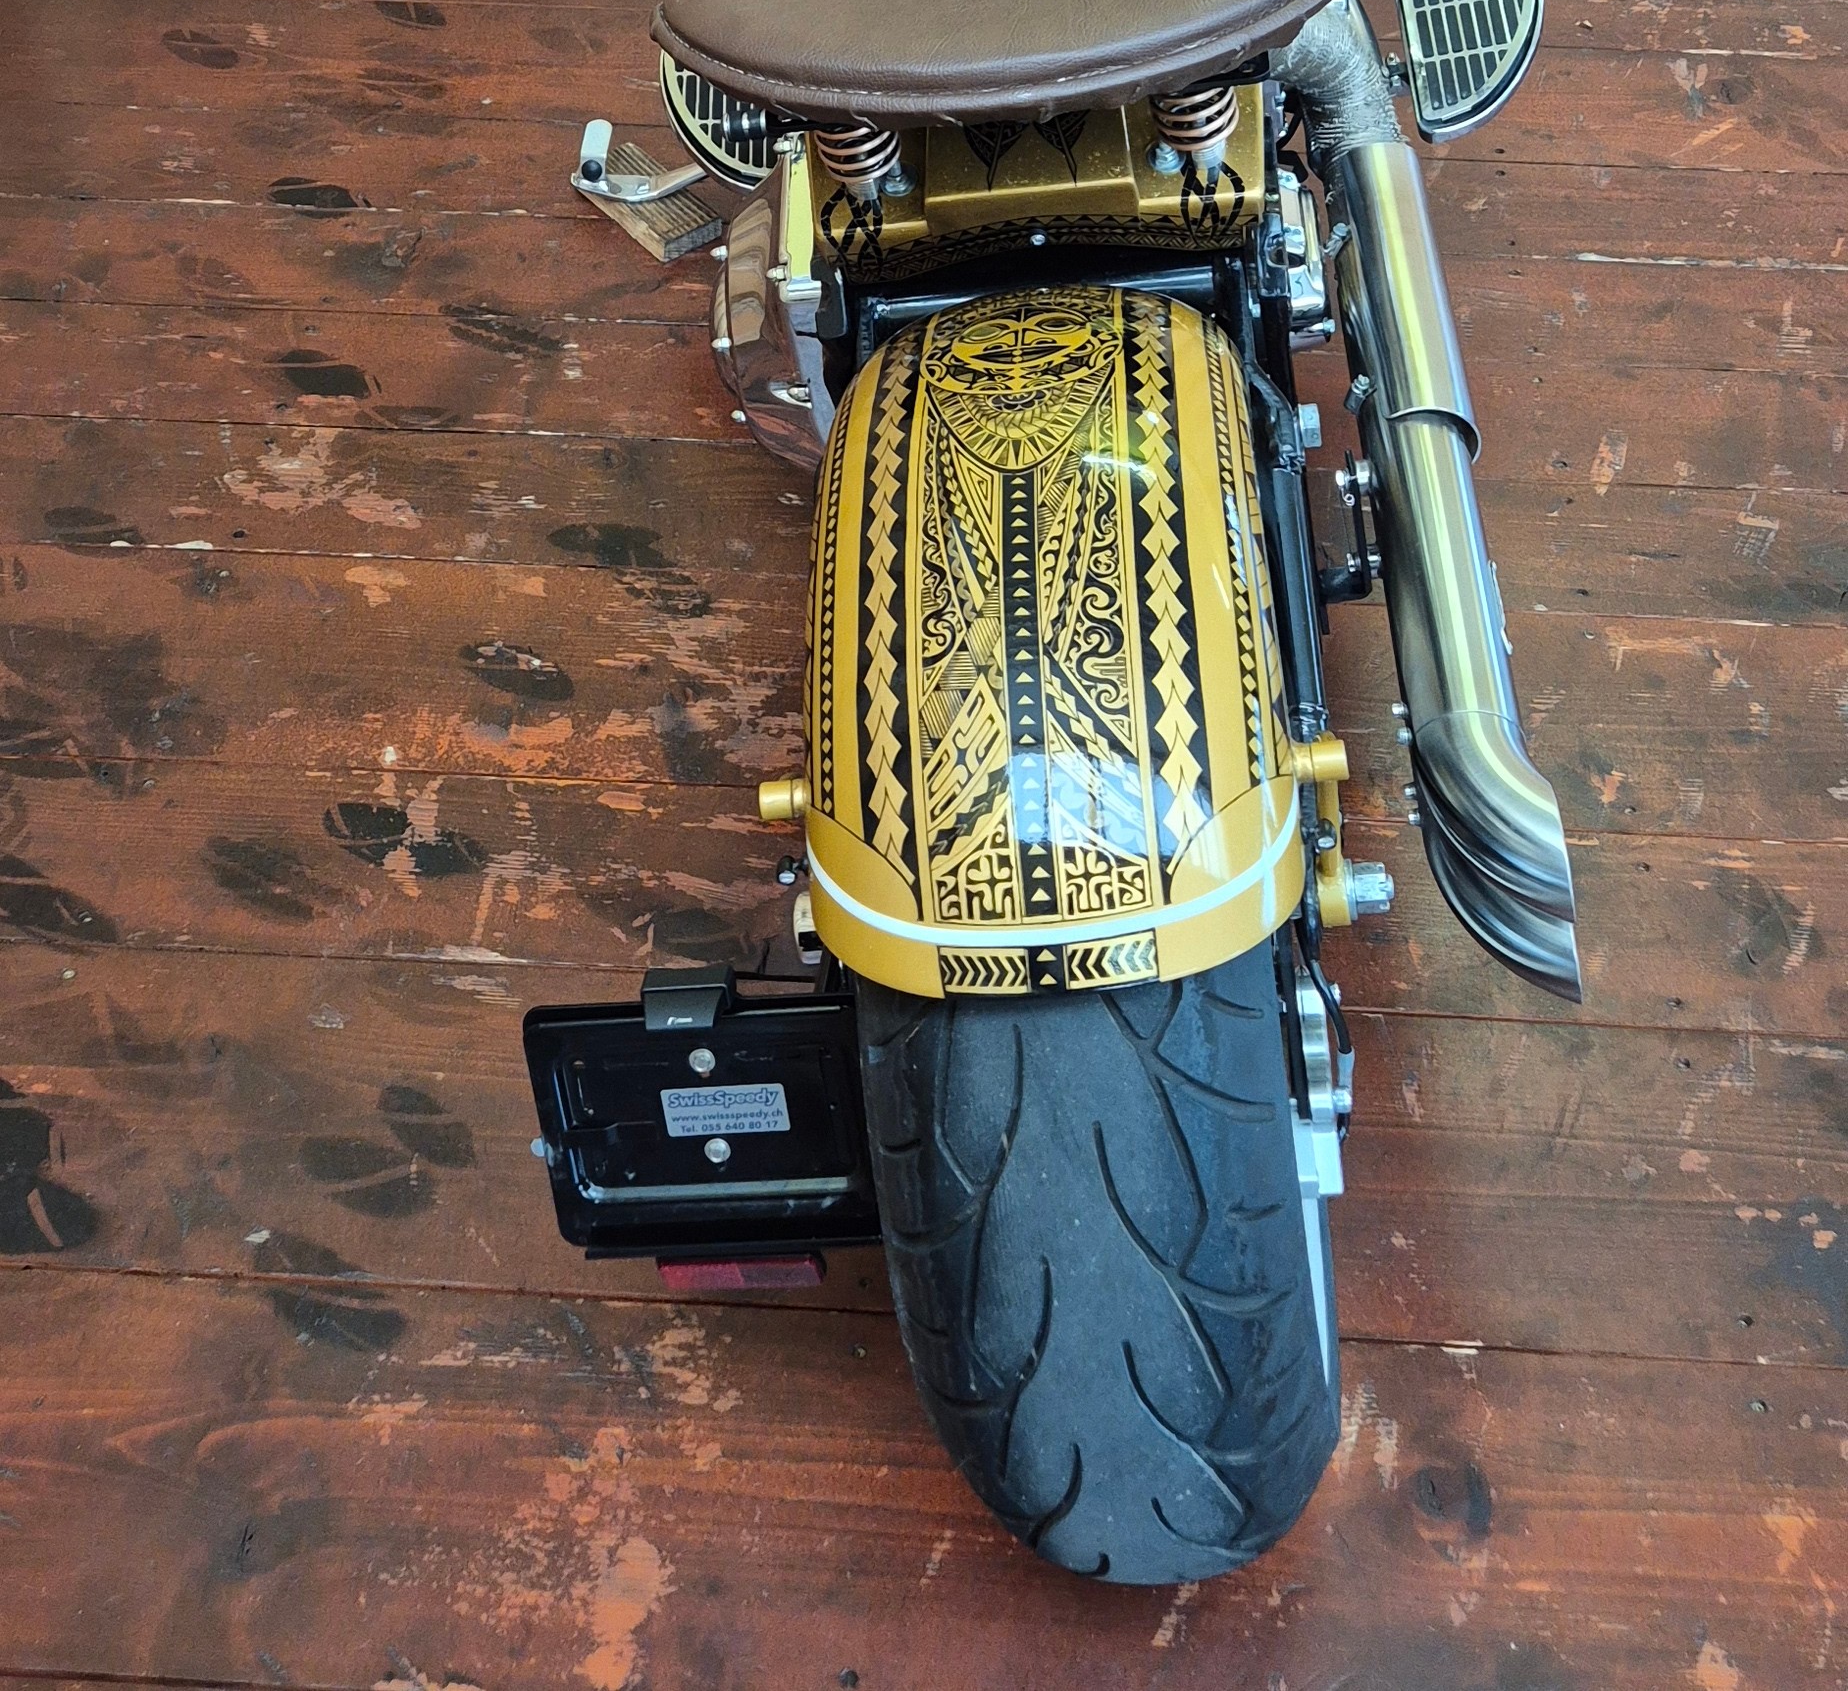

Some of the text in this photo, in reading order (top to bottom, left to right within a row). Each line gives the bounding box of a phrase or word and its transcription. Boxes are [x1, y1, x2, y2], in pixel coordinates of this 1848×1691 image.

[668, 1087, 778, 1108] SwissSpeedy
[671, 1108, 783, 1122] www.swissspeedy.ch
[681, 1120, 778, 1133] Tel. 055 640 80 17
